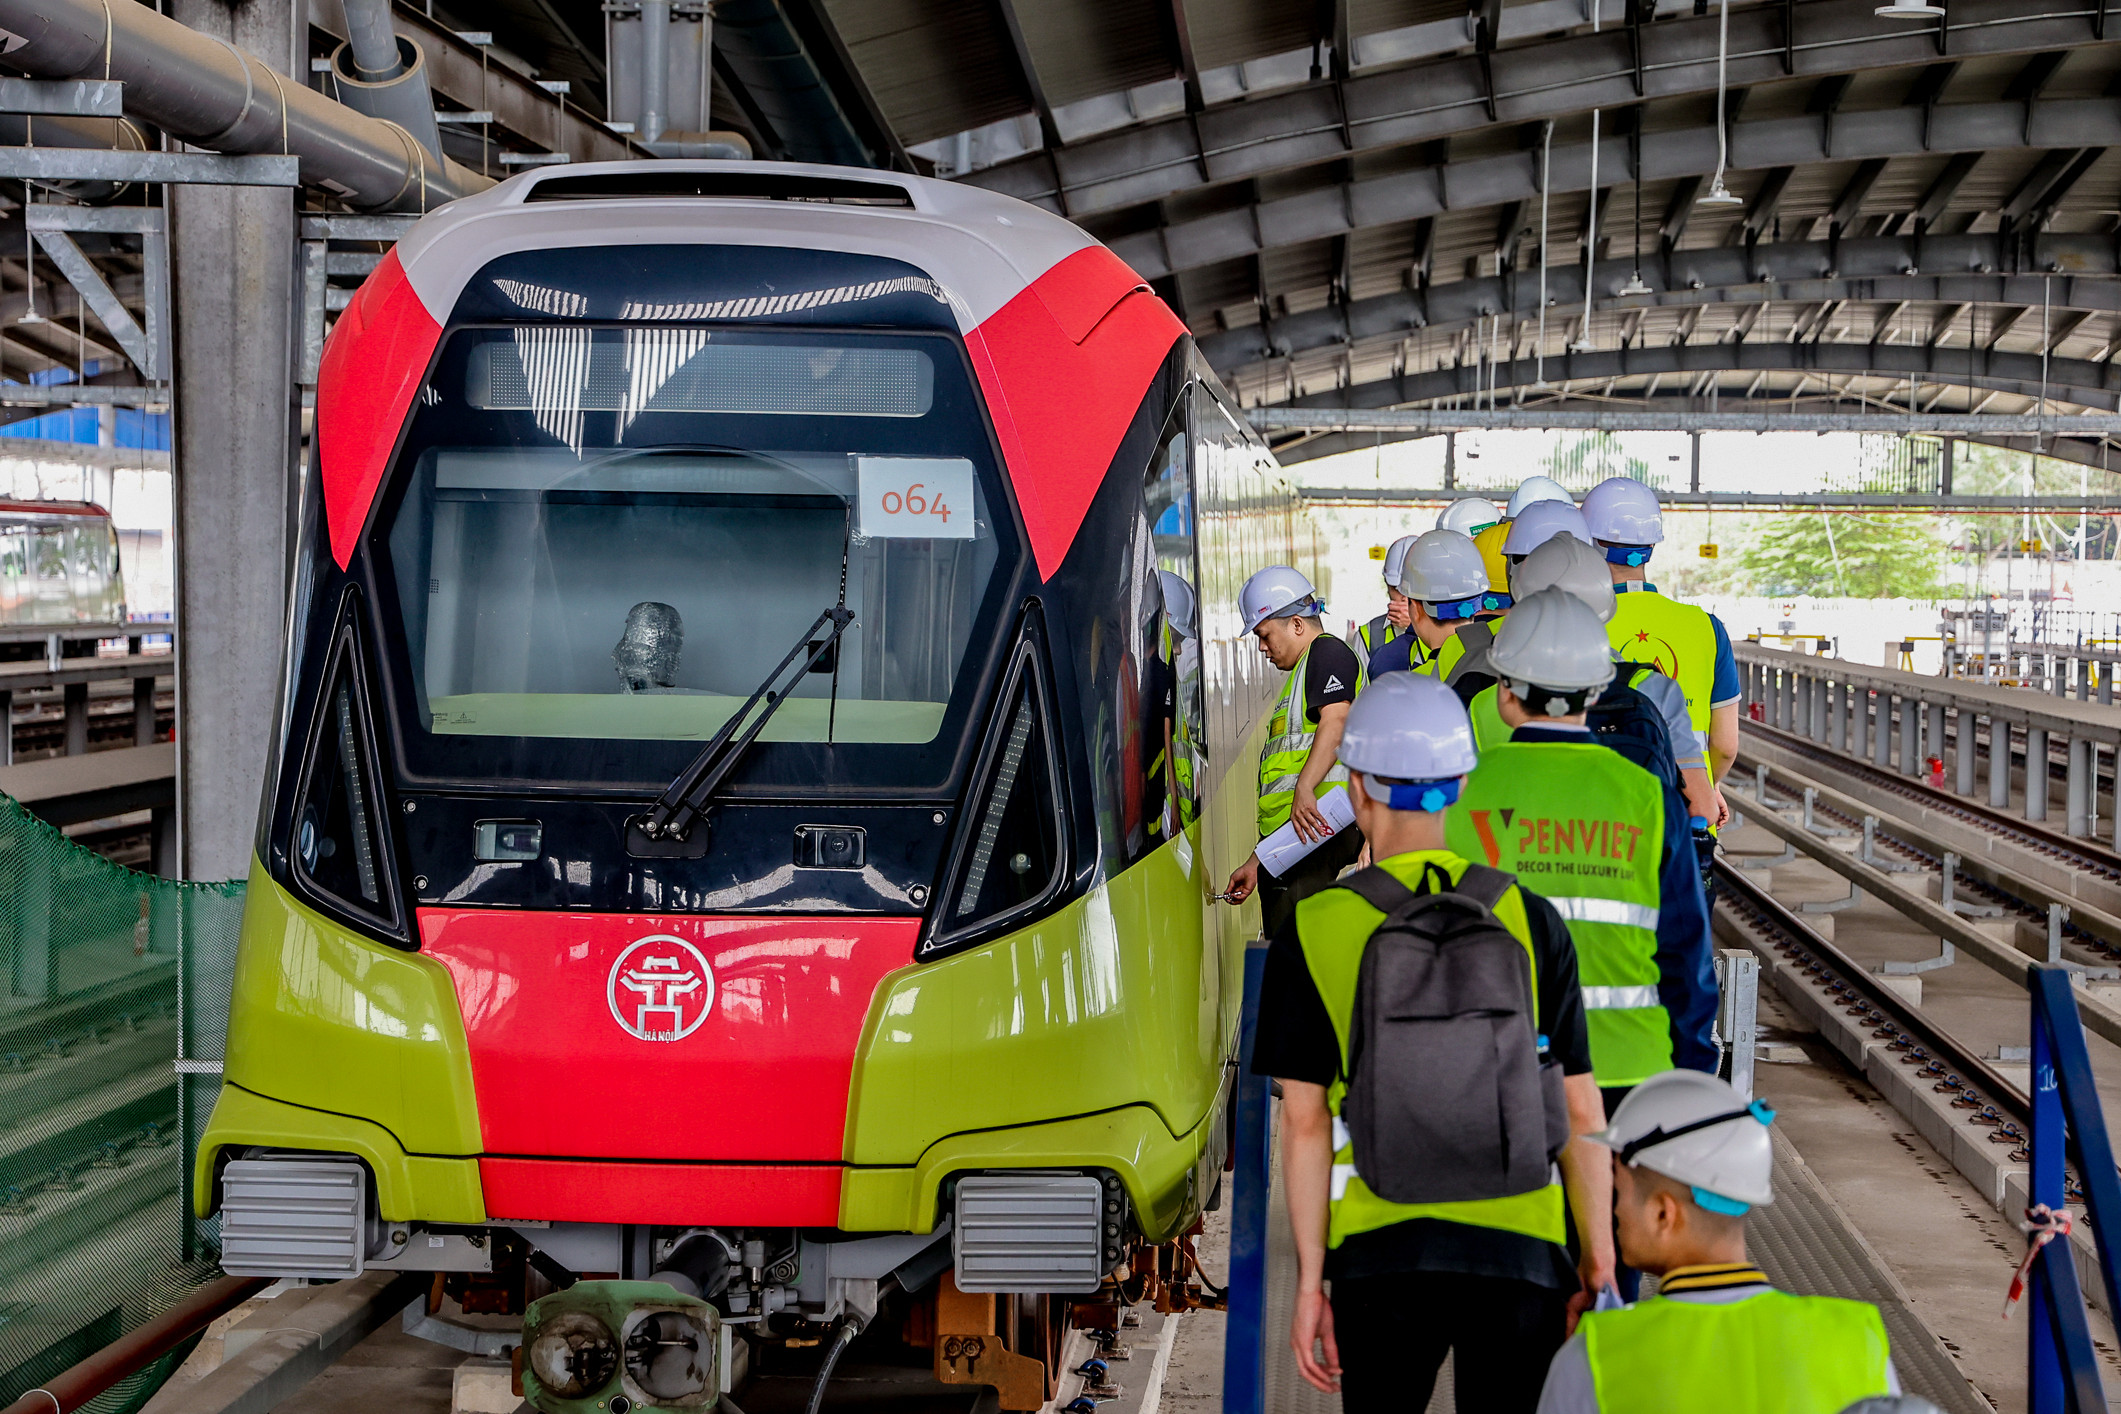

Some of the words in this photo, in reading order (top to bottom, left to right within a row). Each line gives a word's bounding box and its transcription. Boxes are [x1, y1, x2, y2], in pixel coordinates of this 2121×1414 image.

[881, 483, 952, 523] 064
[1323, 684, 1345, 694] Reebok
[1516, 860, 1552, 874] DECOR
[1555, 862, 1575, 875] THE
[1577, 863, 1619, 879] LUXURY
